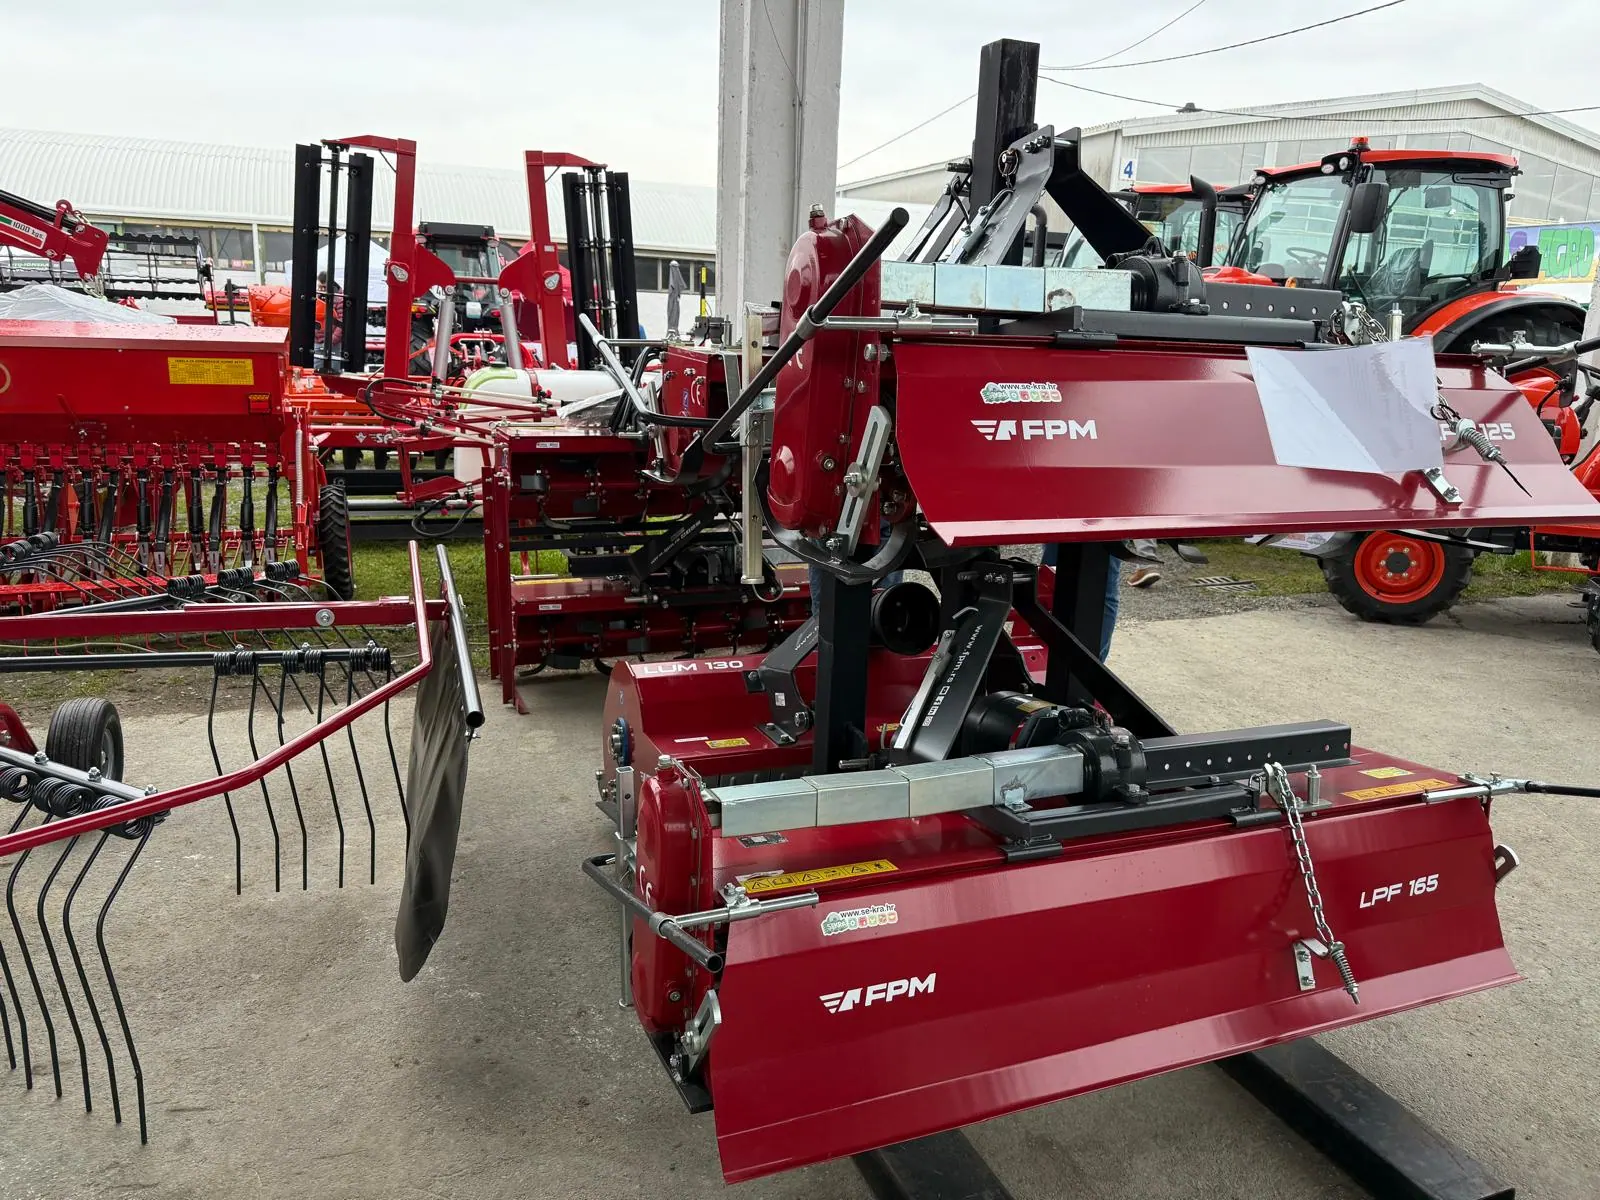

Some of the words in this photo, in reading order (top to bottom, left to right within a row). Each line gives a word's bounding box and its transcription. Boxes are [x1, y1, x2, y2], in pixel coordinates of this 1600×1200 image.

[1123, 160, 1134, 179] 4
[12, 220, 32, 233] 1000
[1538, 226, 1595, 278] AGRO
[999, 382, 1057, 391] www.se-kra.hr
[1021, 419, 1098, 440] FPM
[1478, 422, 1517, 441] 125
[946, 624, 984, 684] www.fpm.rs
[643, 663, 698, 675] LUM
[704, 660, 744, 670] 130
[1359, 882, 1403, 909] LPF
[1408, 873, 1440, 897] 165
[840, 903, 896, 919] www.se-kra.hr
[864, 972, 937, 1007] FPM
